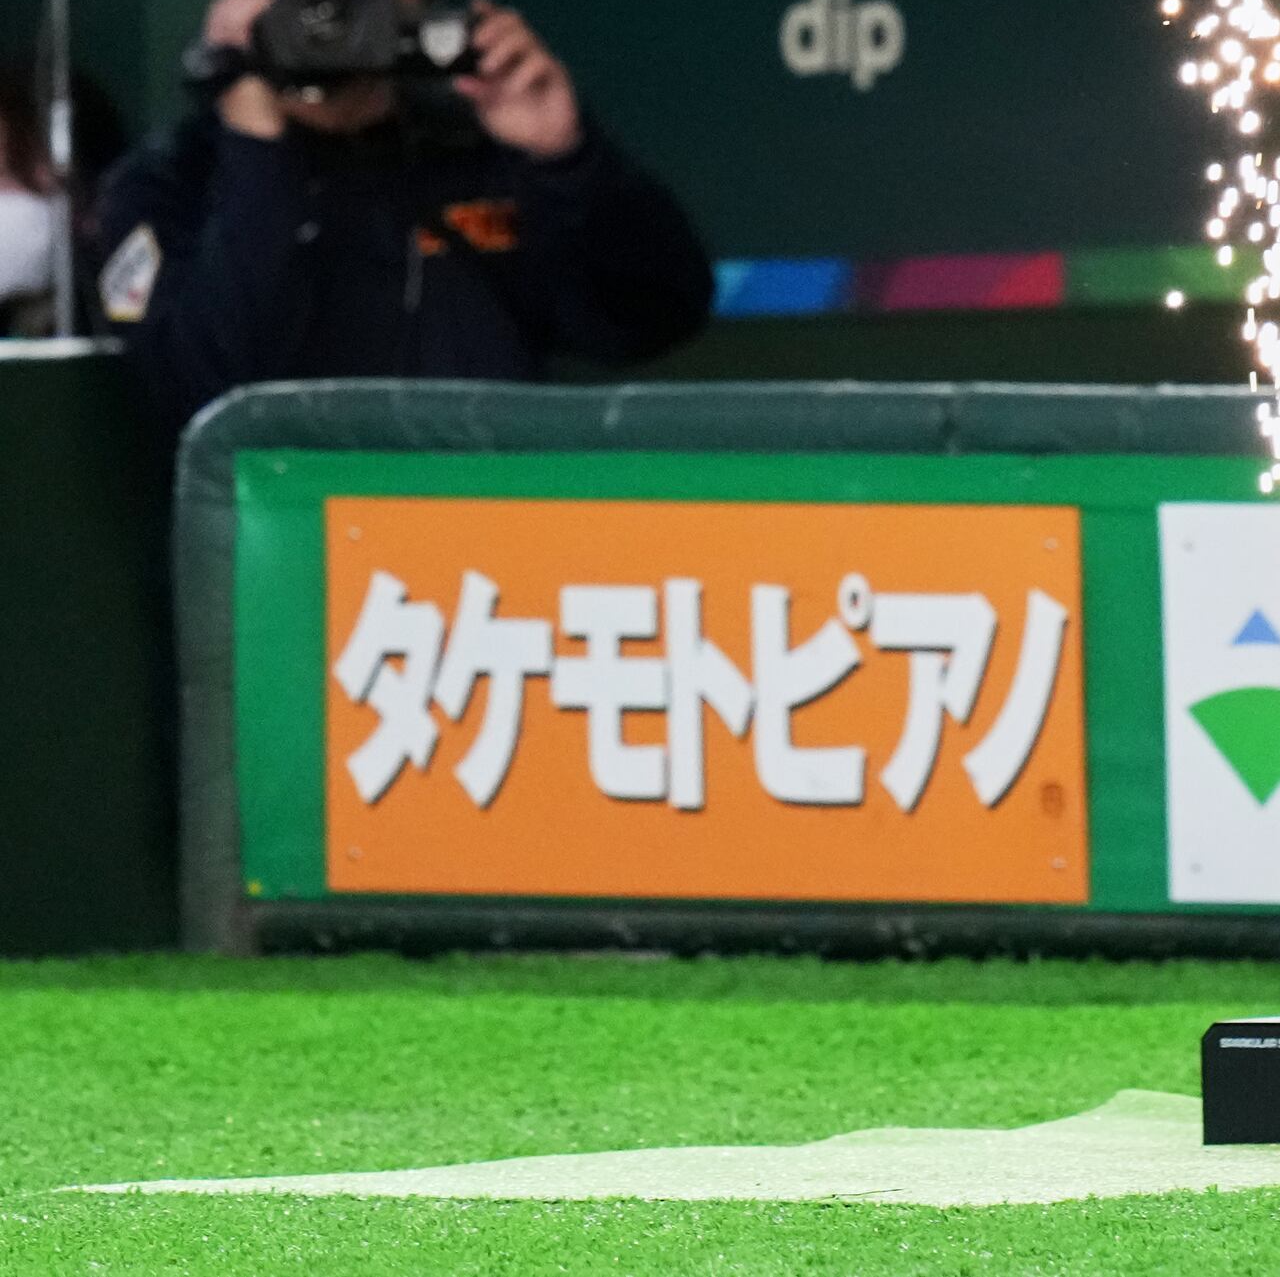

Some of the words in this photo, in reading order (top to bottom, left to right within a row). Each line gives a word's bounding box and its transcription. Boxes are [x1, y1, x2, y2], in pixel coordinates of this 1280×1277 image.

[334, 569, 1067, 812] タケモトピアノ
